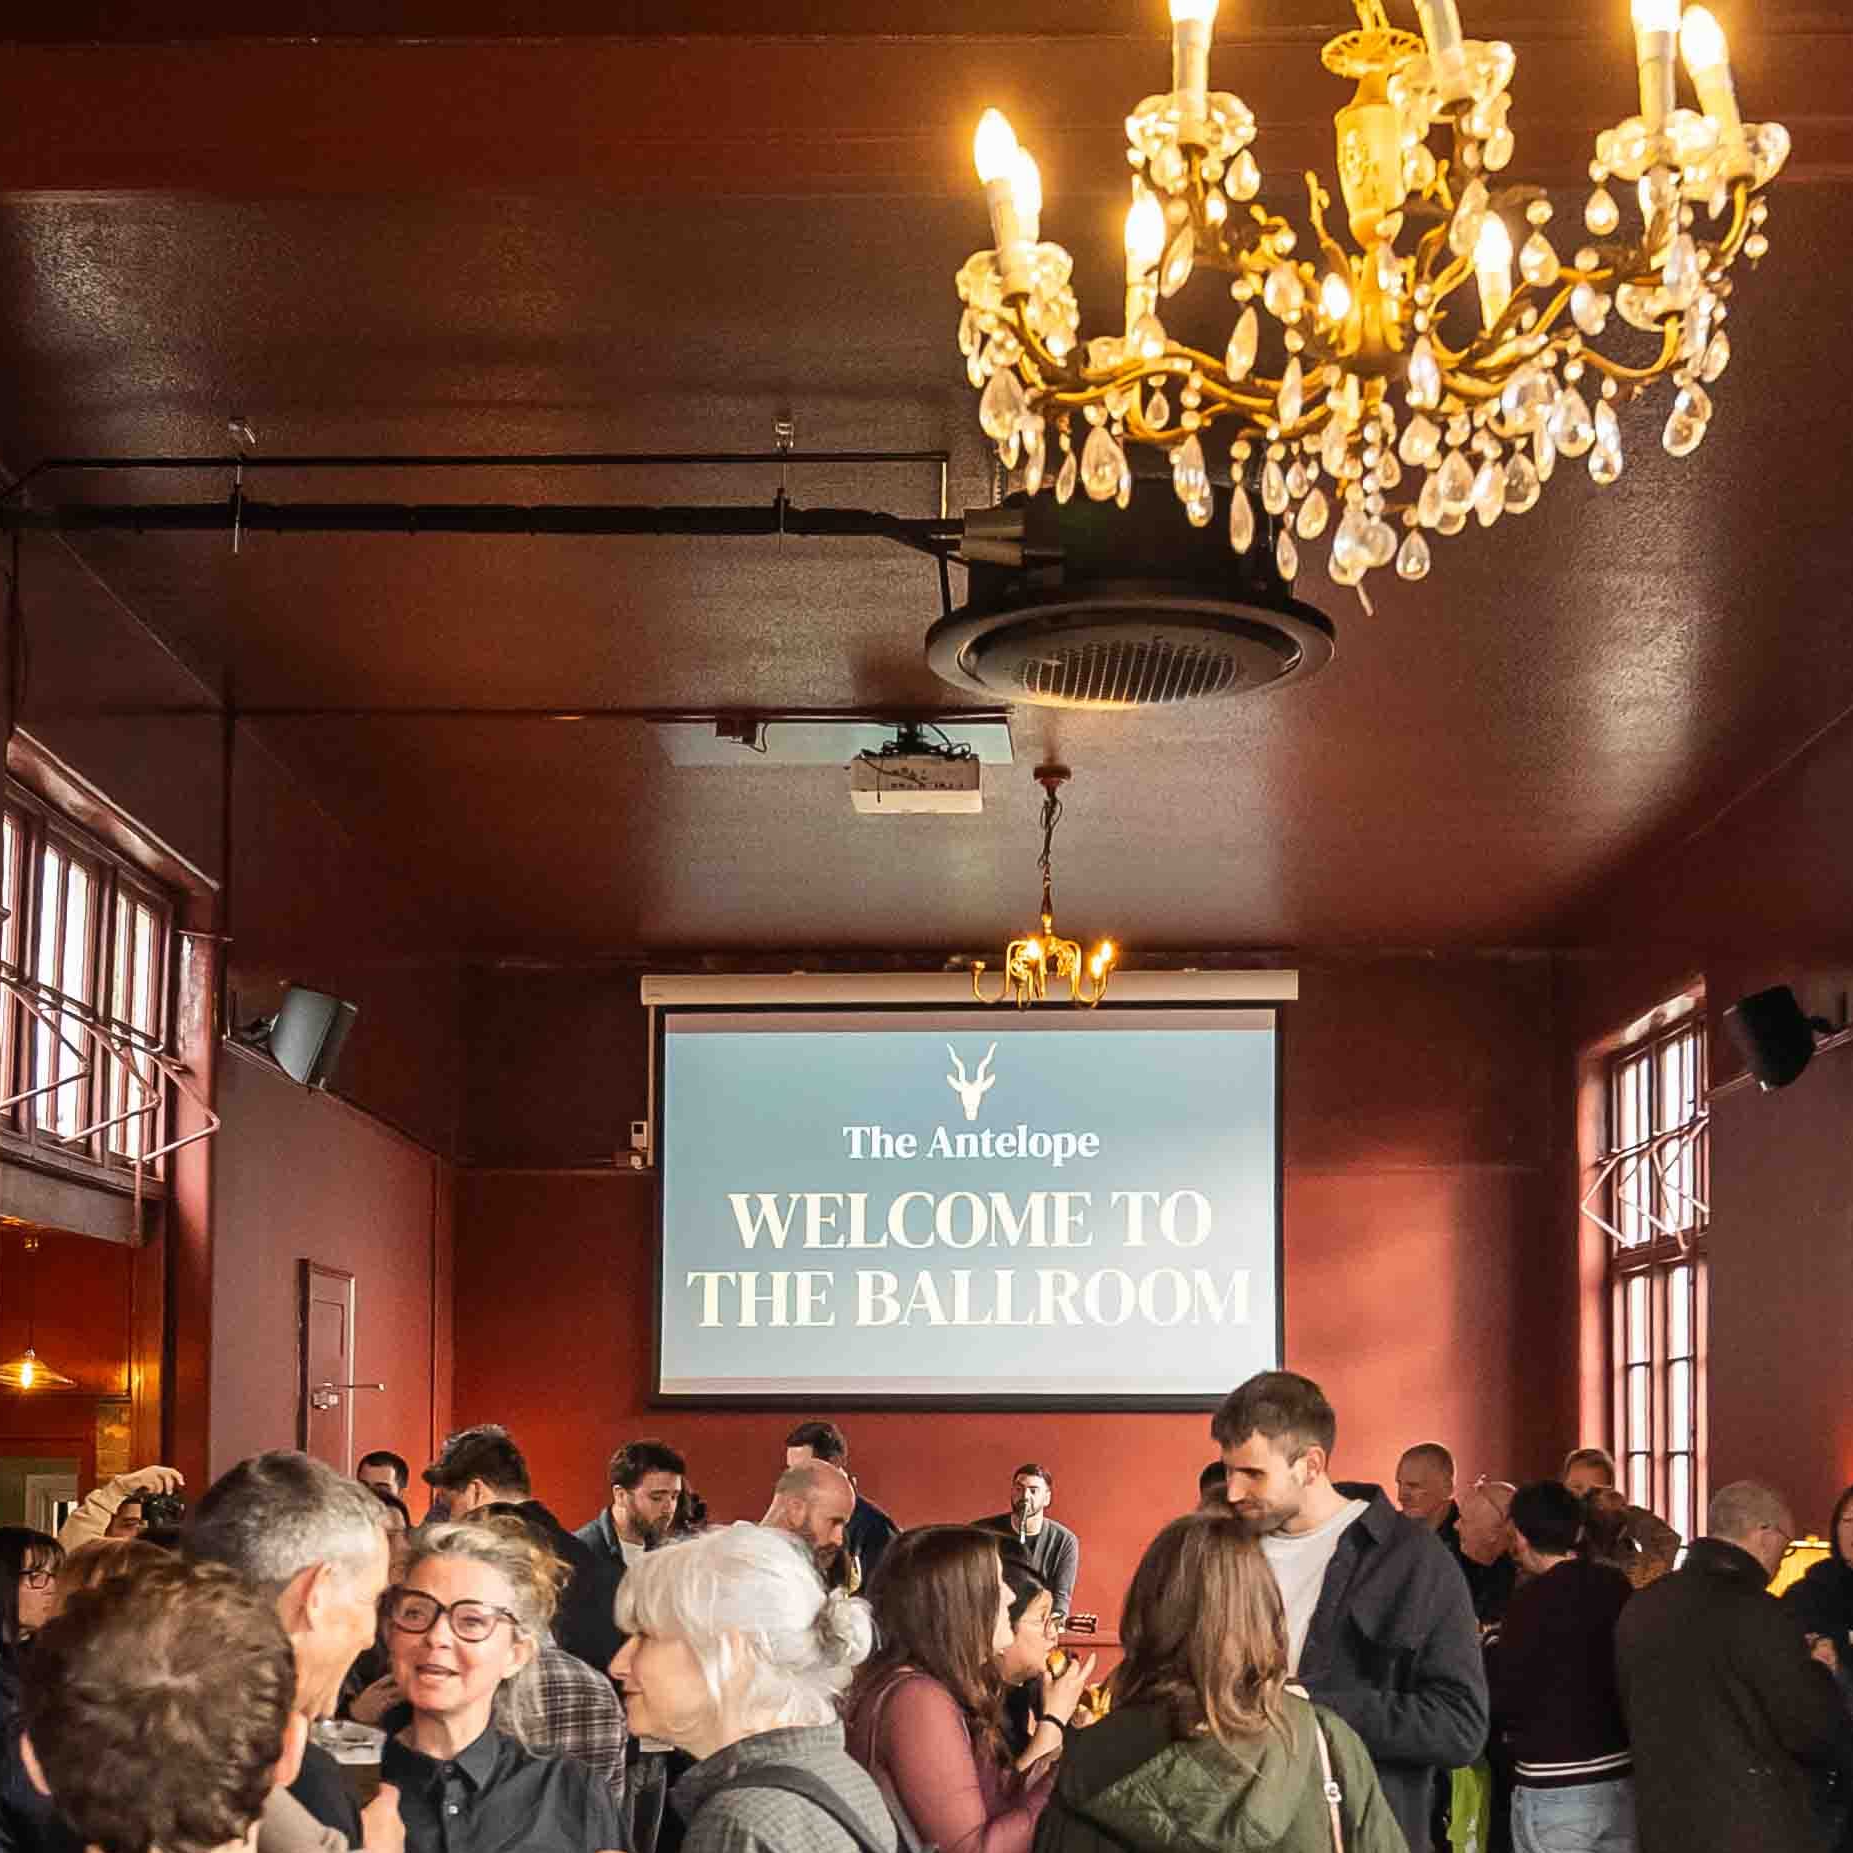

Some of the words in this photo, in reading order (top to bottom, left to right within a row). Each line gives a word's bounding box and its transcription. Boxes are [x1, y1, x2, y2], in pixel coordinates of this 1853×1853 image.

[842, 1125, 917, 1160] The
[925, 1125, 1100, 1167] Antelope
[728, 1191, 1092, 1249] WELCOME
[1109, 1189, 1213, 1248] TO
[686, 1269, 836, 1327] THE
[854, 1268, 1251, 1327] BALLROOM
